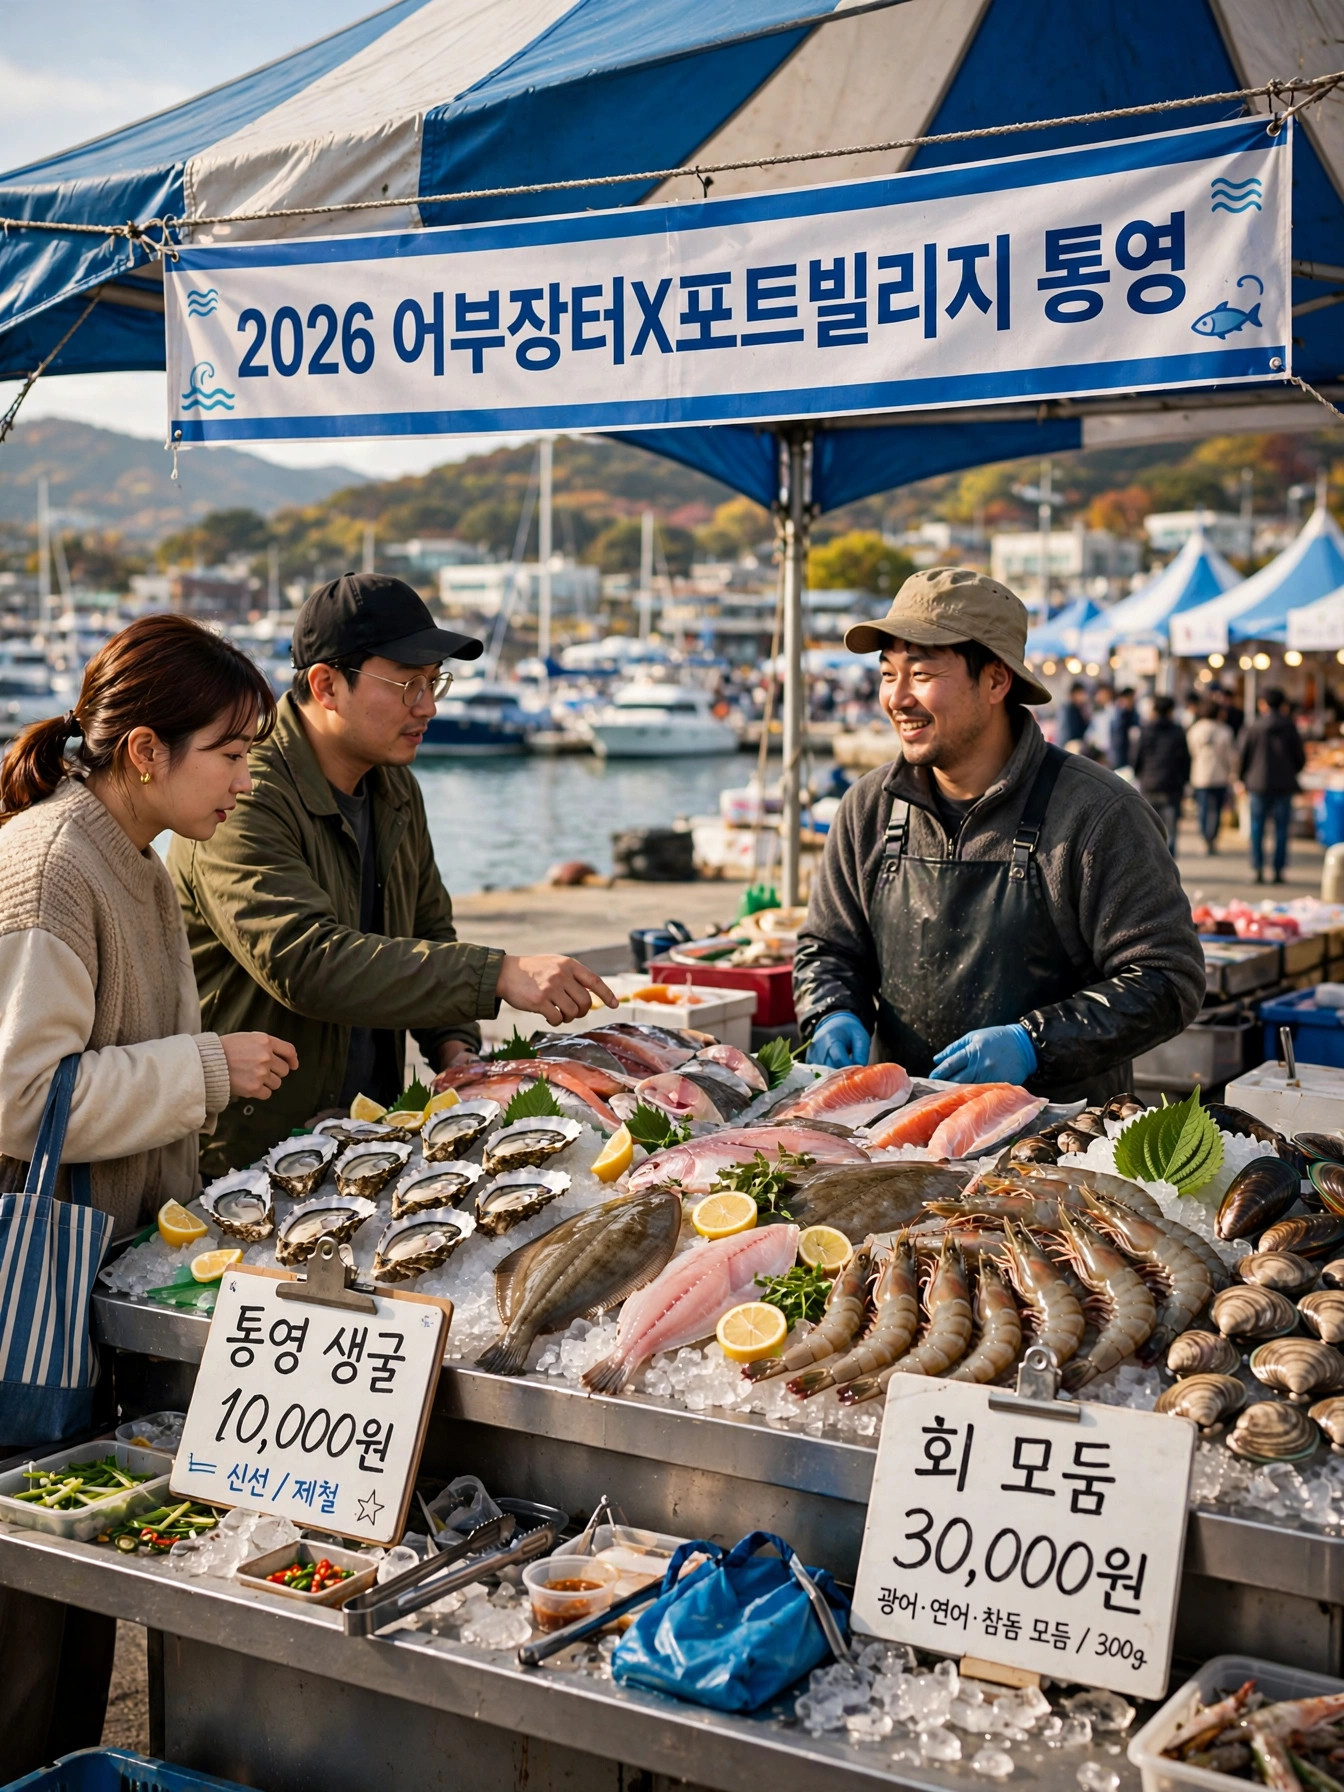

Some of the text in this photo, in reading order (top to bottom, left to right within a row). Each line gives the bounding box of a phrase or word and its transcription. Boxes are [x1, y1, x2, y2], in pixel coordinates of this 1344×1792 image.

[237, 210, 1187, 379] 2026 어부장터X포트빌리지 통영
[225, 1305, 406, 1394] 통영 생굴
[215, 1387, 394, 1474] 10,000원
[914, 1415, 1117, 1516] 회 모둠
[226, 1463, 270, 1498] 신선
[291, 1479, 339, 1514] 제철
[892, 1507, 1148, 1616] 30,000원
[1029, 1618, 1071, 1651] 모듬
[1094, 1632, 1148, 1671] 300g
